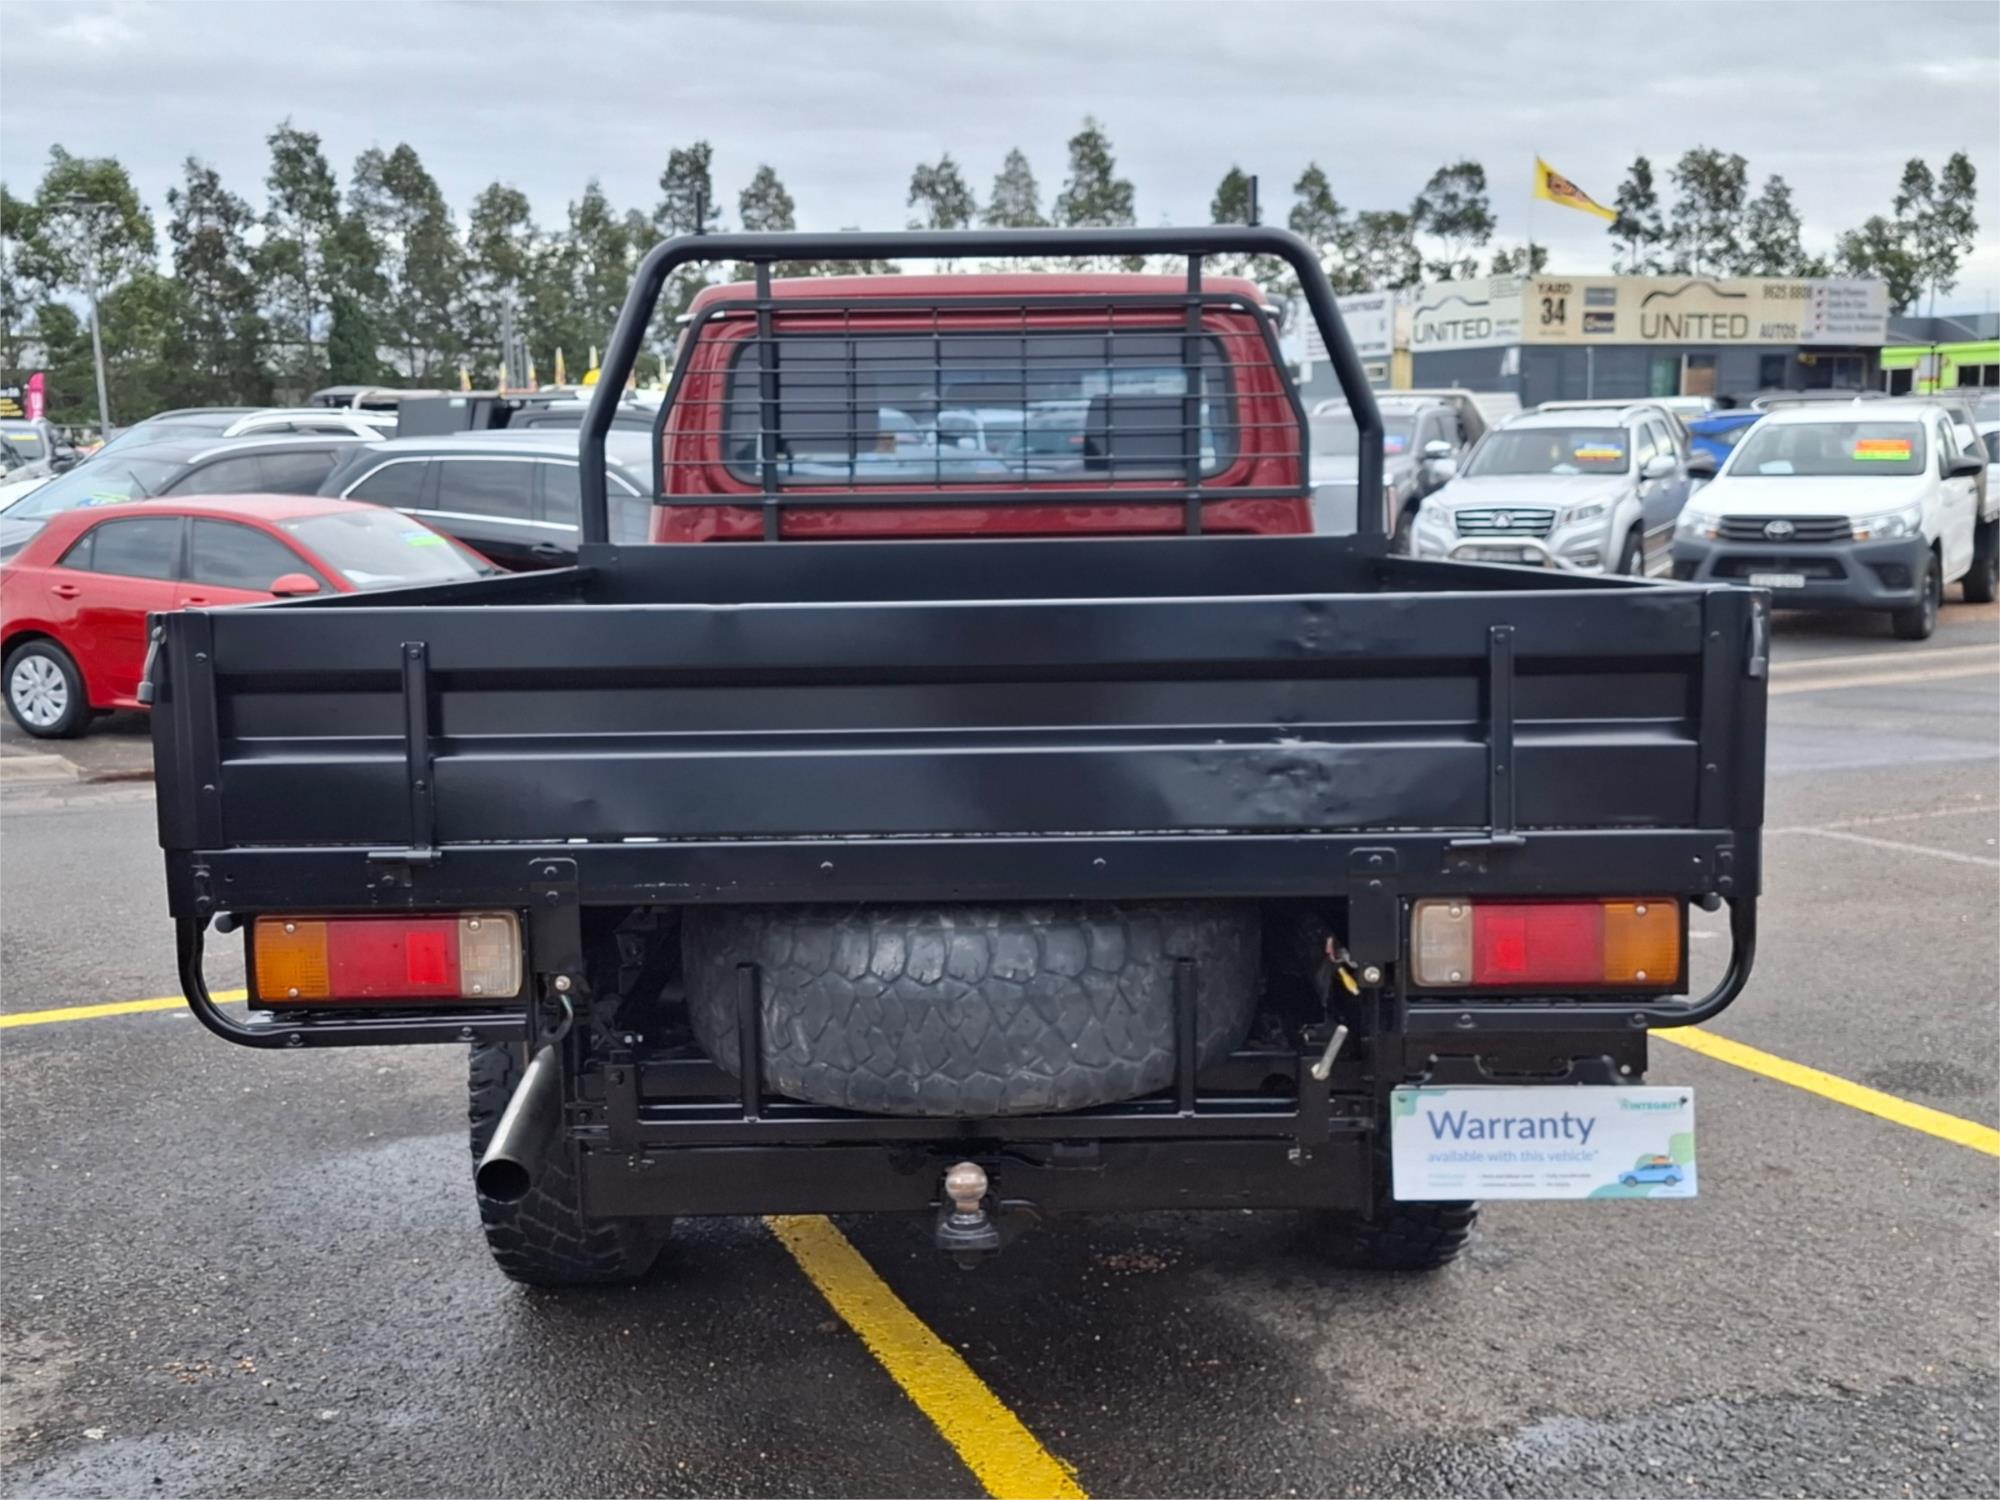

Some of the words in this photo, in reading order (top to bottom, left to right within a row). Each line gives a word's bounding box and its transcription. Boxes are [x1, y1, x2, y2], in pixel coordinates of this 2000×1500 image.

[1537, 283, 1572, 295] YARD
[1541, 297, 1565, 325] 34
[1760, 322, 1797, 339] AUTOS
[1427, 1110, 1596, 1145] Warranty
[1427, 1151, 1484, 1163] available
[1487, 1150, 1517, 1163] with
[1520, 1150, 1545, 1163] this
